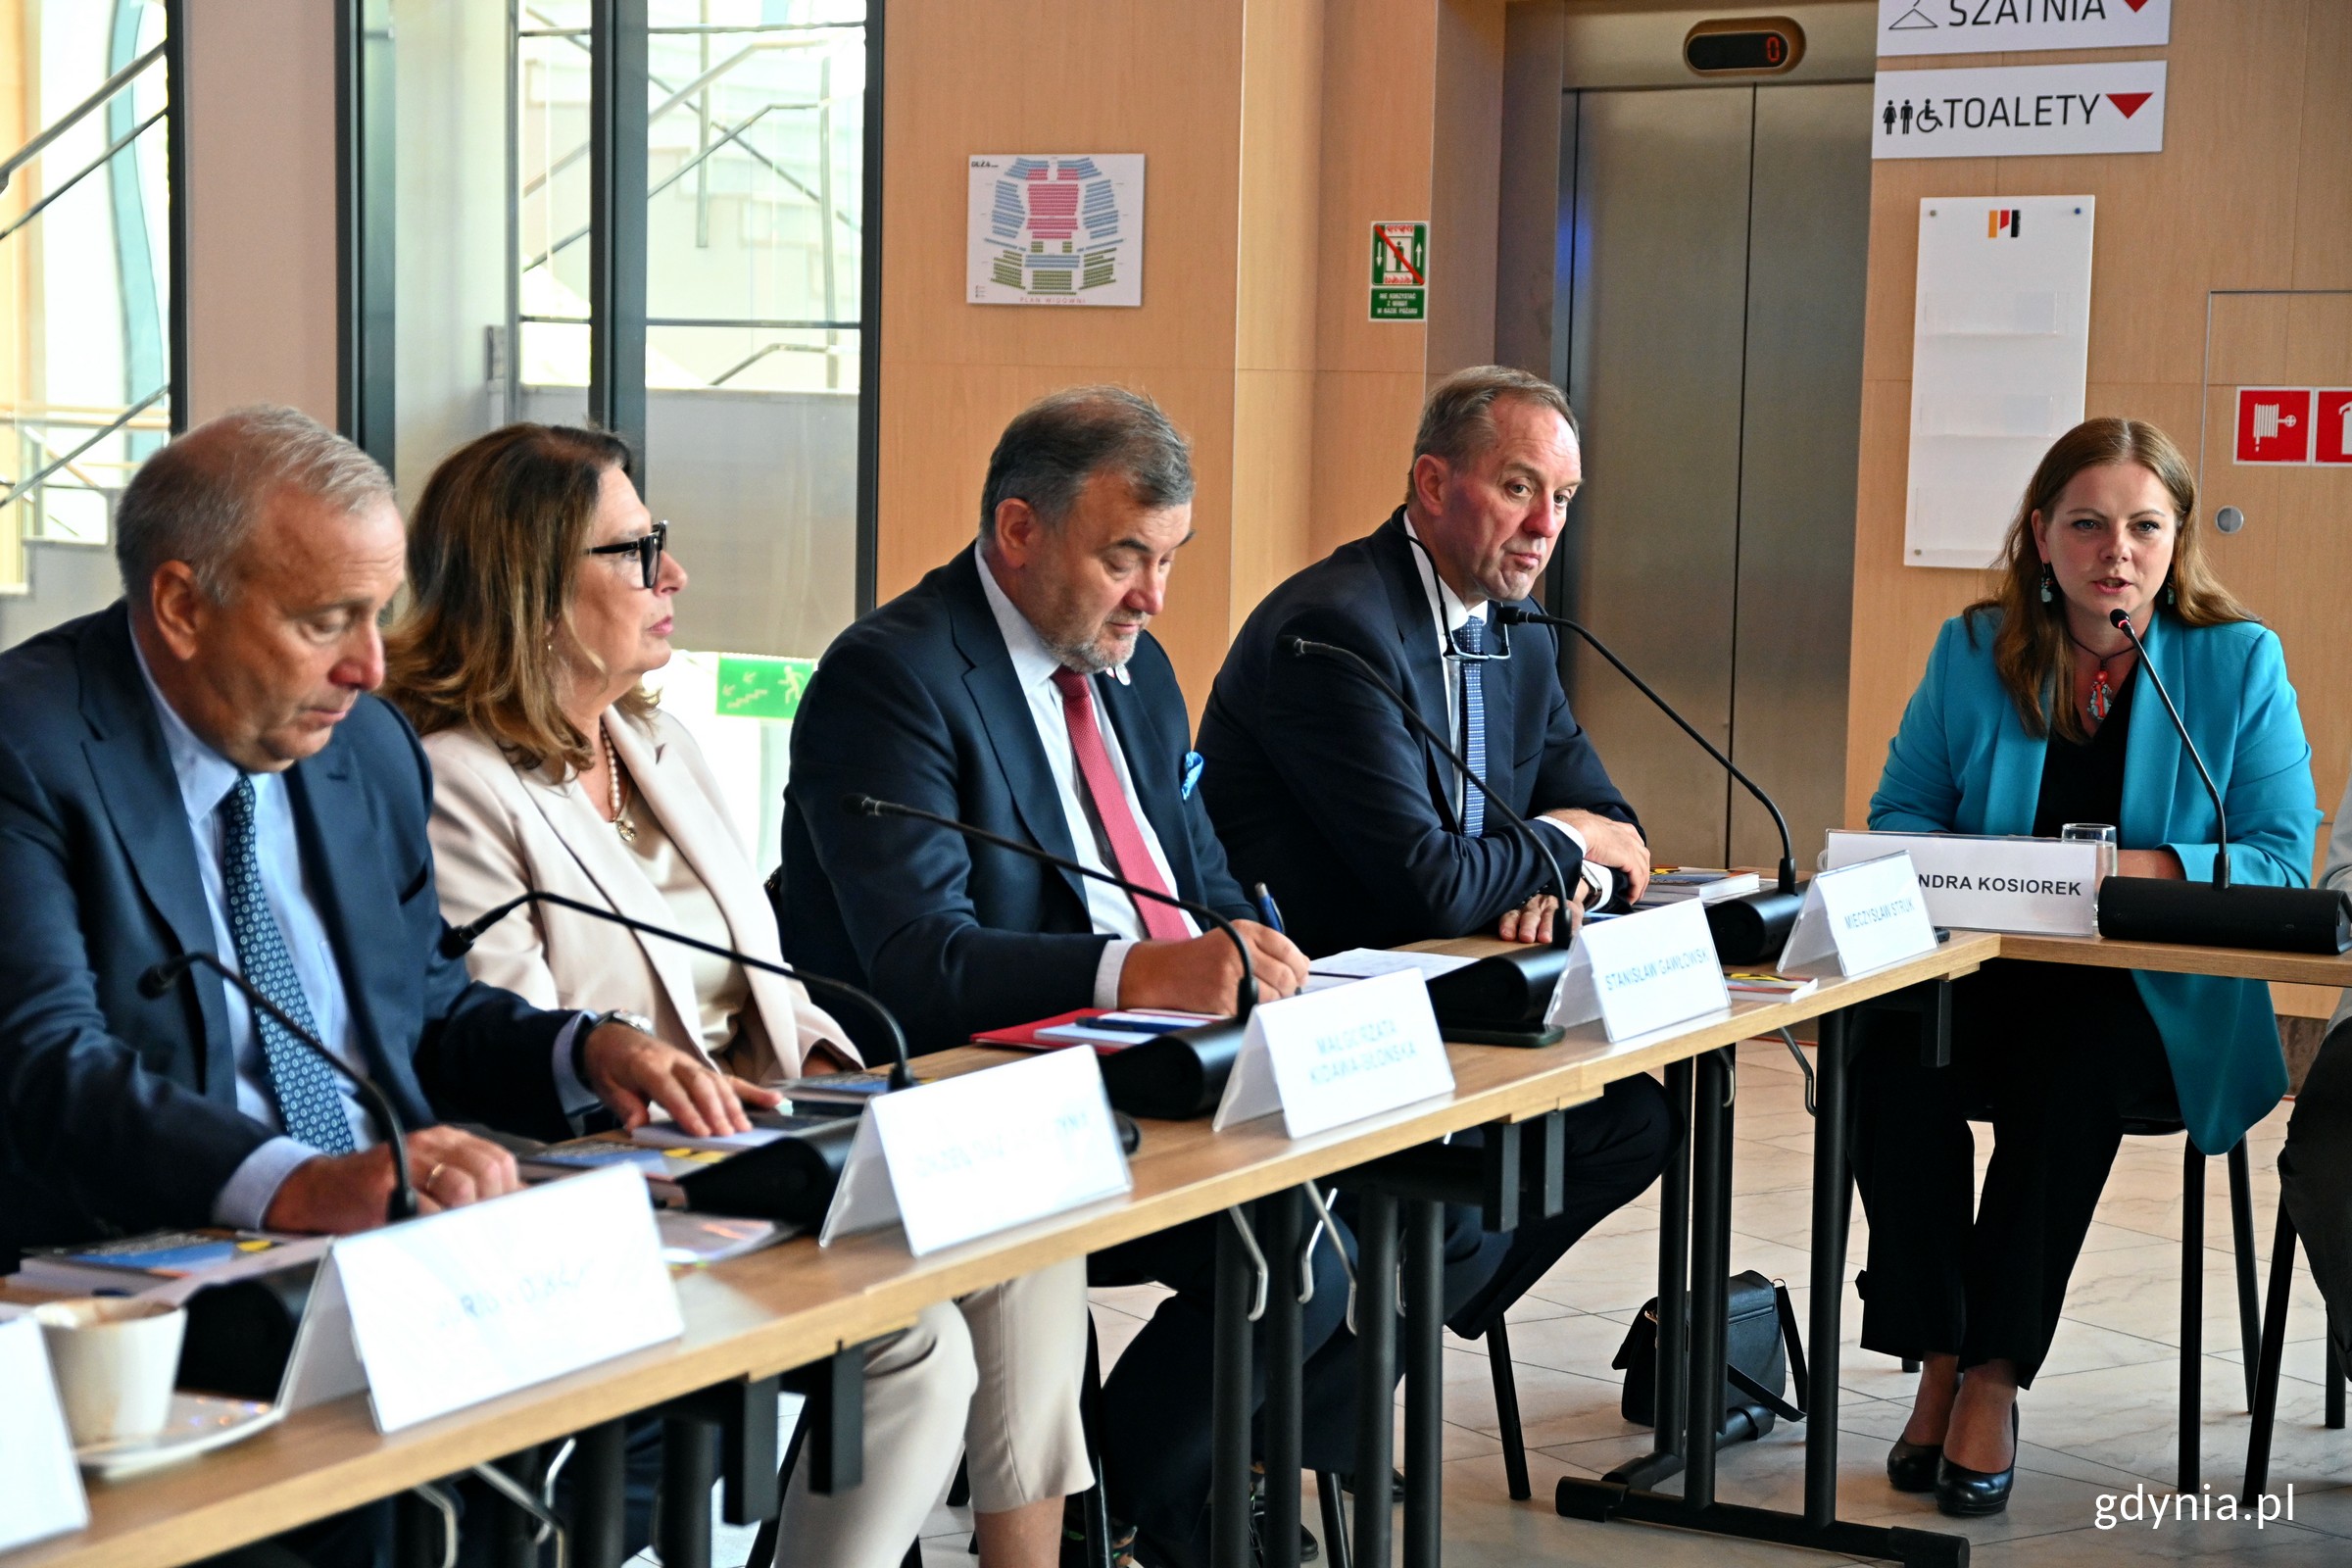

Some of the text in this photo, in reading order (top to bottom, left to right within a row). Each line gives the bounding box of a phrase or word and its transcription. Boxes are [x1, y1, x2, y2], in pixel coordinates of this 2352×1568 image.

[1949, 0, 2106, 26] SZATNIA
[1943, 93, 2100, 129] TOALETY
[1918, 874, 2082, 897] NDRA KOSIOREK
[1890, 898, 1915, 917] STRUK
